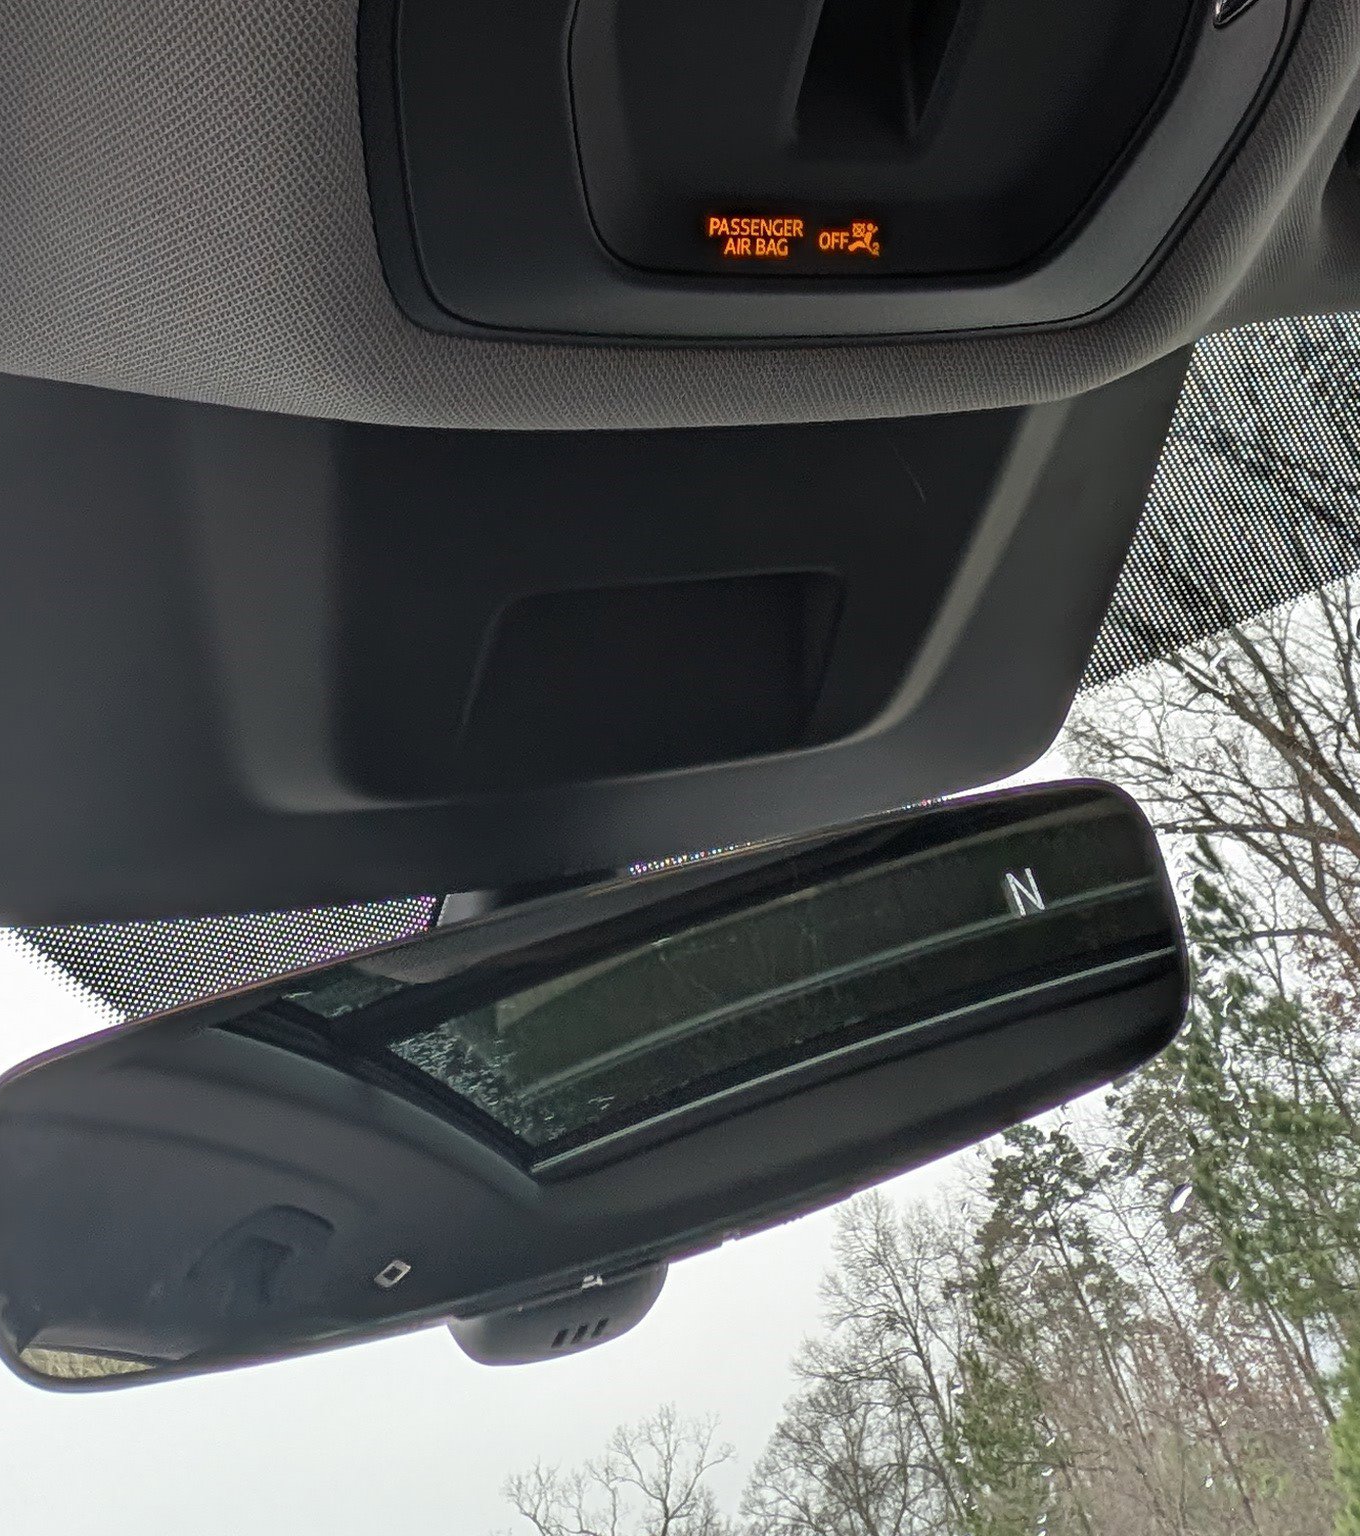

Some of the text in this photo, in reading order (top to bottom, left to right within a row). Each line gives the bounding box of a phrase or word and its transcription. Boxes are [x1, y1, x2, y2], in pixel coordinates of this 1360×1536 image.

[708, 217, 804, 237] PASSENGER
[723, 238, 789, 257] AIR BAG
[818, 231, 850, 250] OFF
[1005, 866, 1046, 917] N
